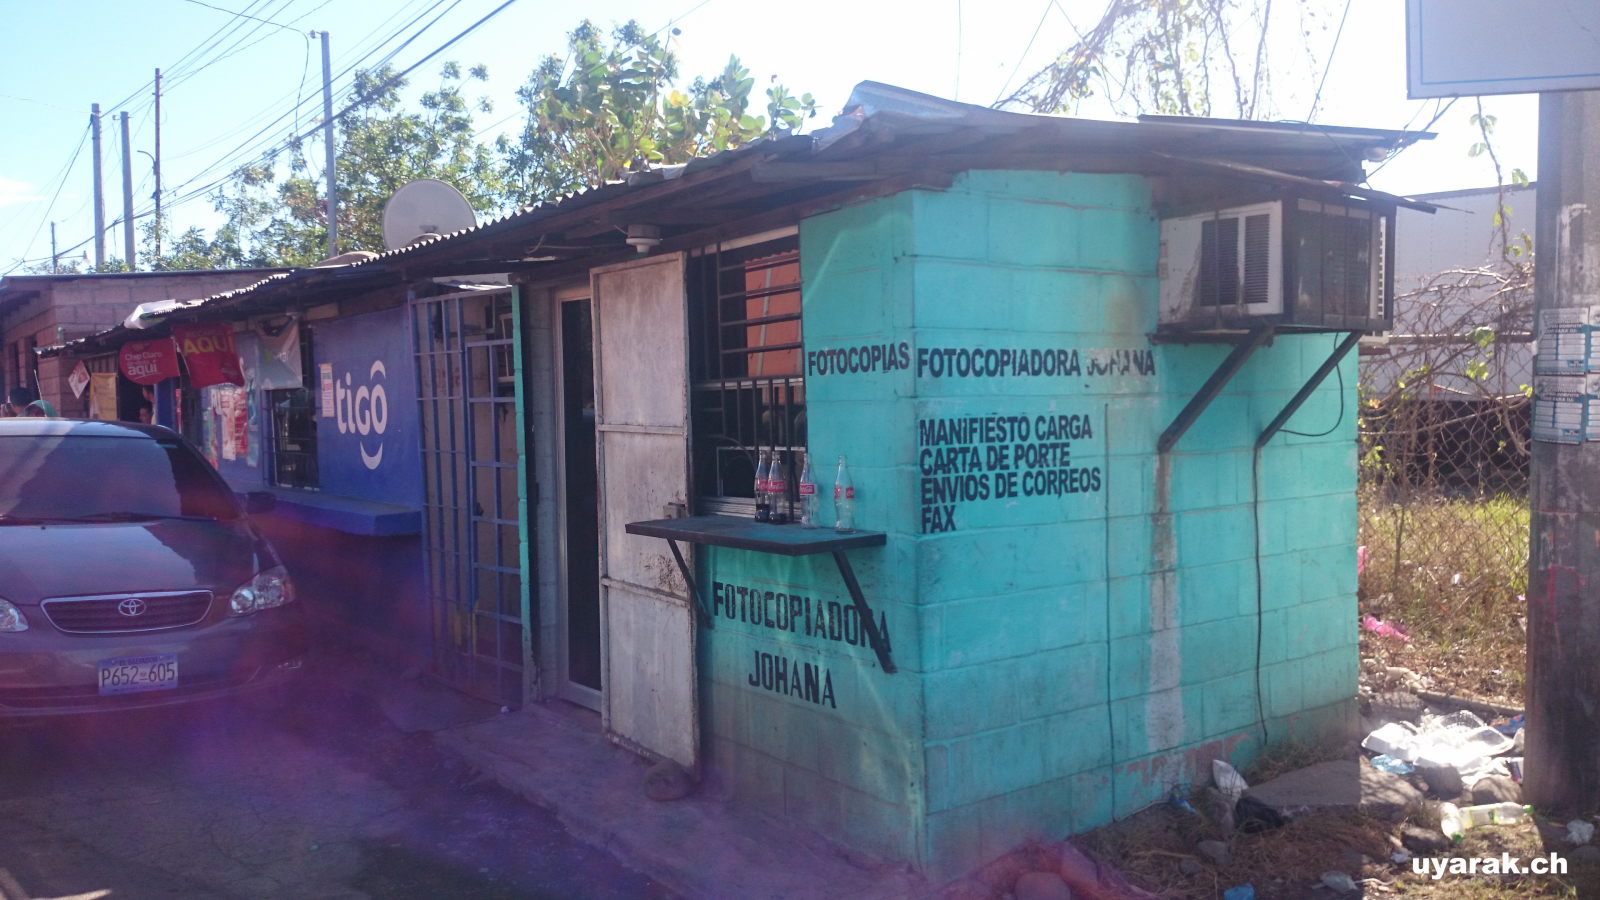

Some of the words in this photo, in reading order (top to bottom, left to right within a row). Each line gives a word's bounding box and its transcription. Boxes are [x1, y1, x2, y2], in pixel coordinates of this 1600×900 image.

[808, 342, 909, 377] FOTOCOPIAS
[917, 347, 1081, 378] FOTOCOPIADORA
[919, 415, 1031, 446] MANIFIESTO
[1034, 414, 1093, 441] CARGA
[920, 446, 982, 476] CARTA
[986, 444, 1010, 471] DE
[1013, 442, 1071, 469] PORTE
[921, 474, 990, 504] ENVIOS
[994, 472, 1018, 499] DE
[1022, 467, 1101, 498] CORREOS
[921, 504, 957, 534] FAX
[748, 650, 837, 709] JOHANA
